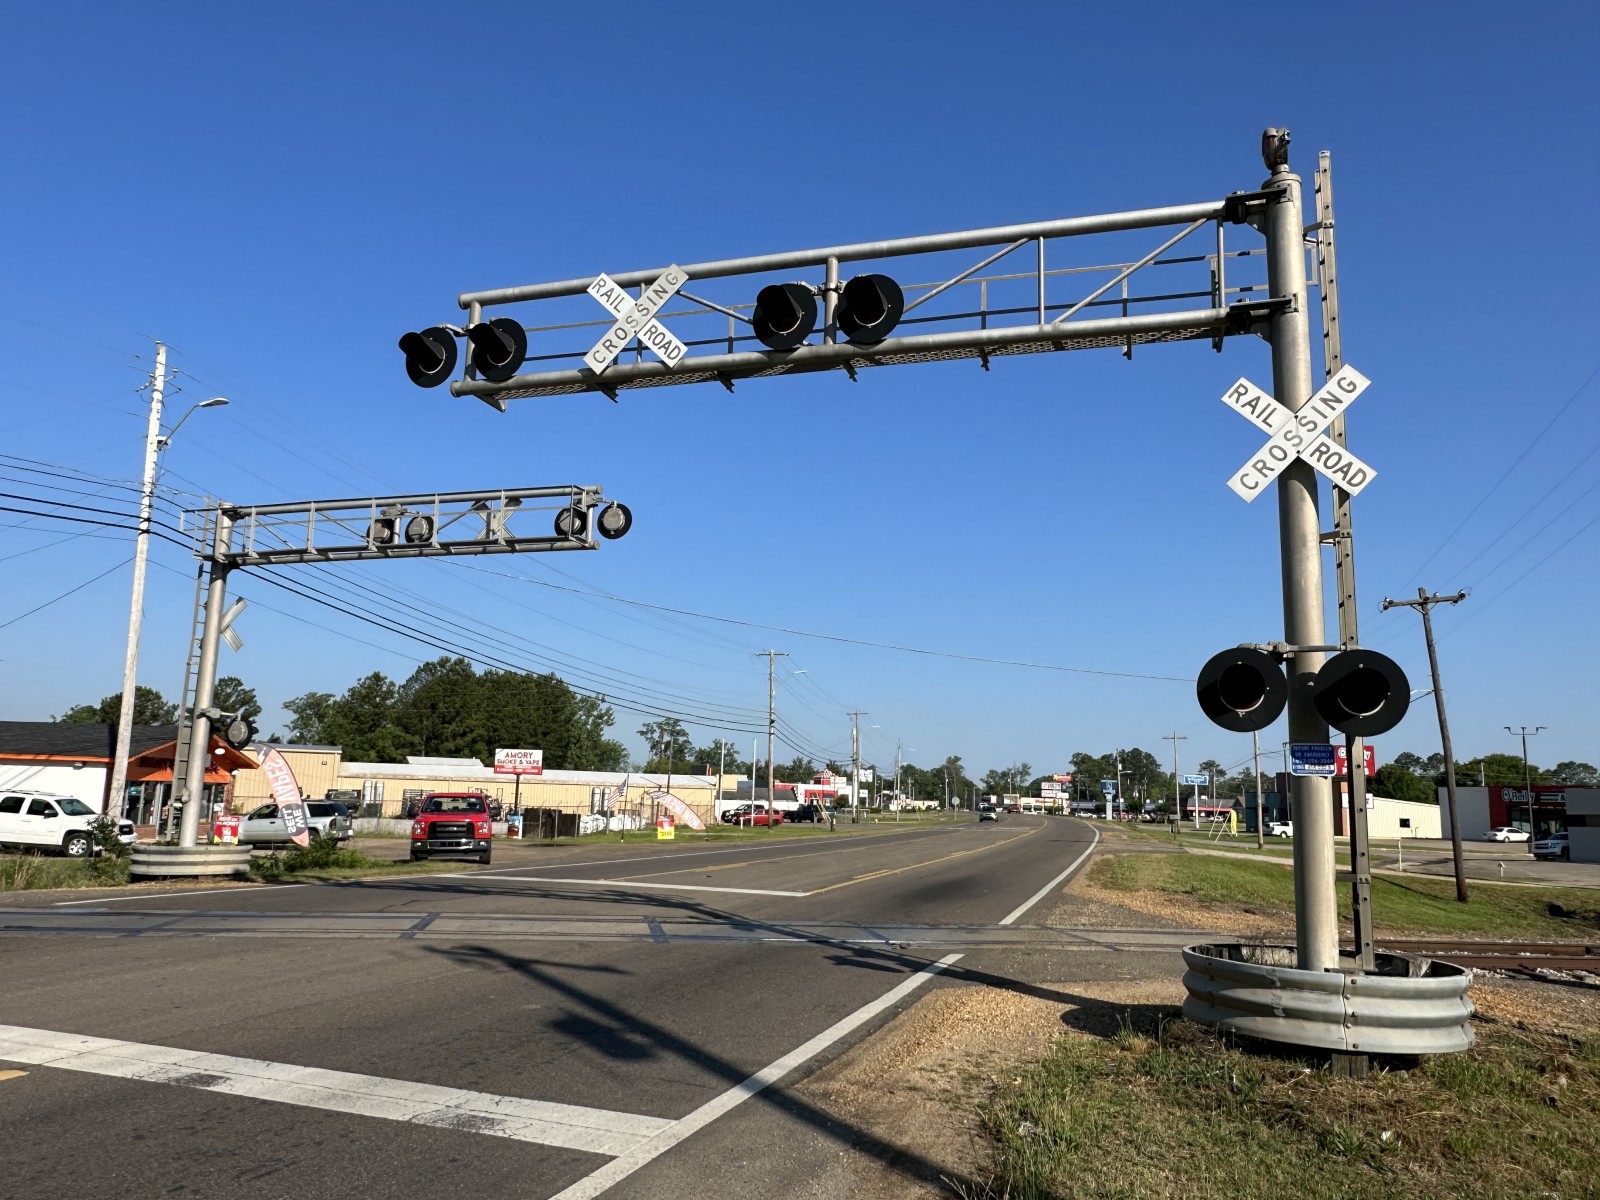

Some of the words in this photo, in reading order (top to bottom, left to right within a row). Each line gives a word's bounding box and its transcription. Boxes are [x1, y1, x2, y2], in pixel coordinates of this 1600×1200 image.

[591, 277, 625, 314] RAIL
[643, 323, 682, 361] ROAD
[592, 272, 679, 364] CROSSING
[1227, 382, 1278, 428] RAIL
[1309, 441, 1367, 488] ROAD
[1239, 376, 1357, 490] CROSSING
[505, 751, 534, 759] AMORY
